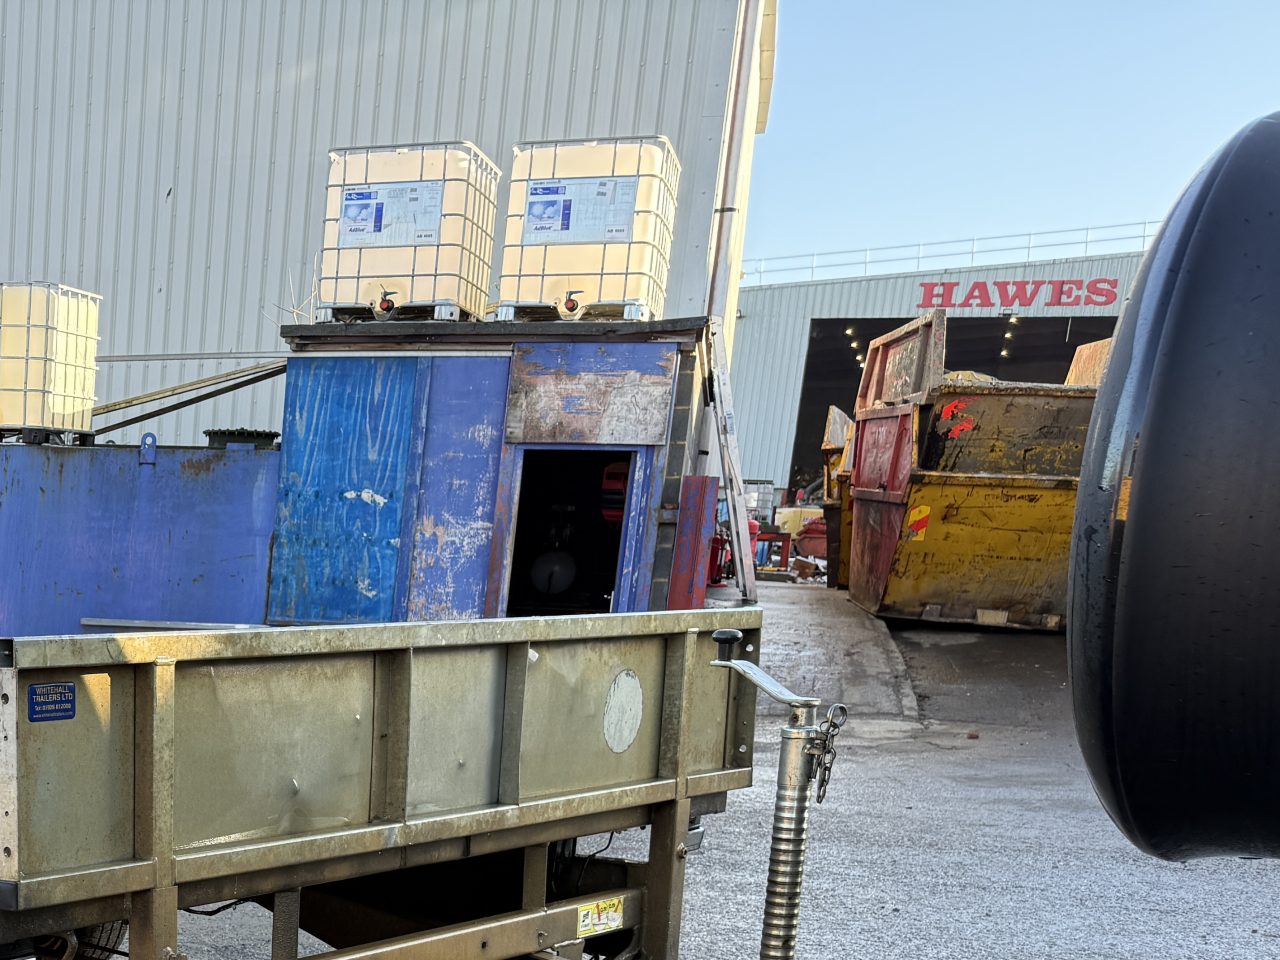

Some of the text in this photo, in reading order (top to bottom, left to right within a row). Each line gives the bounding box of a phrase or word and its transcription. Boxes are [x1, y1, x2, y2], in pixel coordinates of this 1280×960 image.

[916, 278, 1119, 309] HAWES
[35, 686, 70, 694] WHITEHALL
[32, 693, 73, 702] TRAILERS LTD
